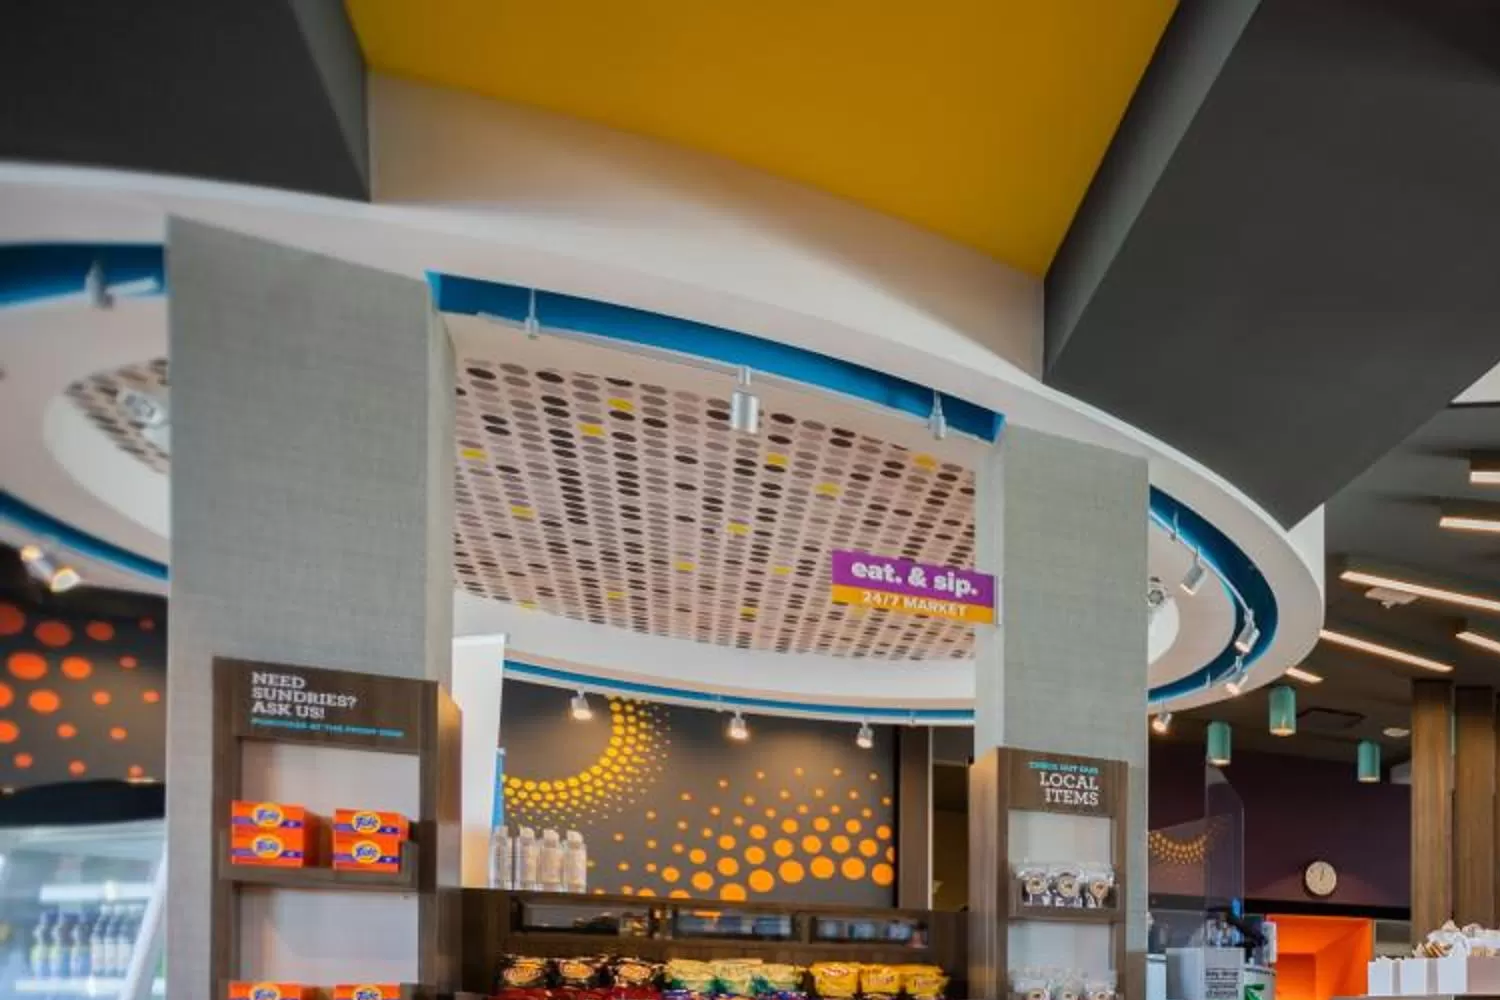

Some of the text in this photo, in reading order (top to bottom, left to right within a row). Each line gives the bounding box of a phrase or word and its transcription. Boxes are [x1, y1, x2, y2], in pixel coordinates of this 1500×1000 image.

[851, 562, 979, 598] eat. & sip.
[863, 591, 967, 617] 24/7 MARKET
[252, 671, 305, 689] NEED
[251, 687, 358, 709] SUNDRIES?
[251, 701, 325, 719] ASK US!
[1039, 771, 1099, 790] LOCAL
[1045, 787, 1099, 806] ITEMS
